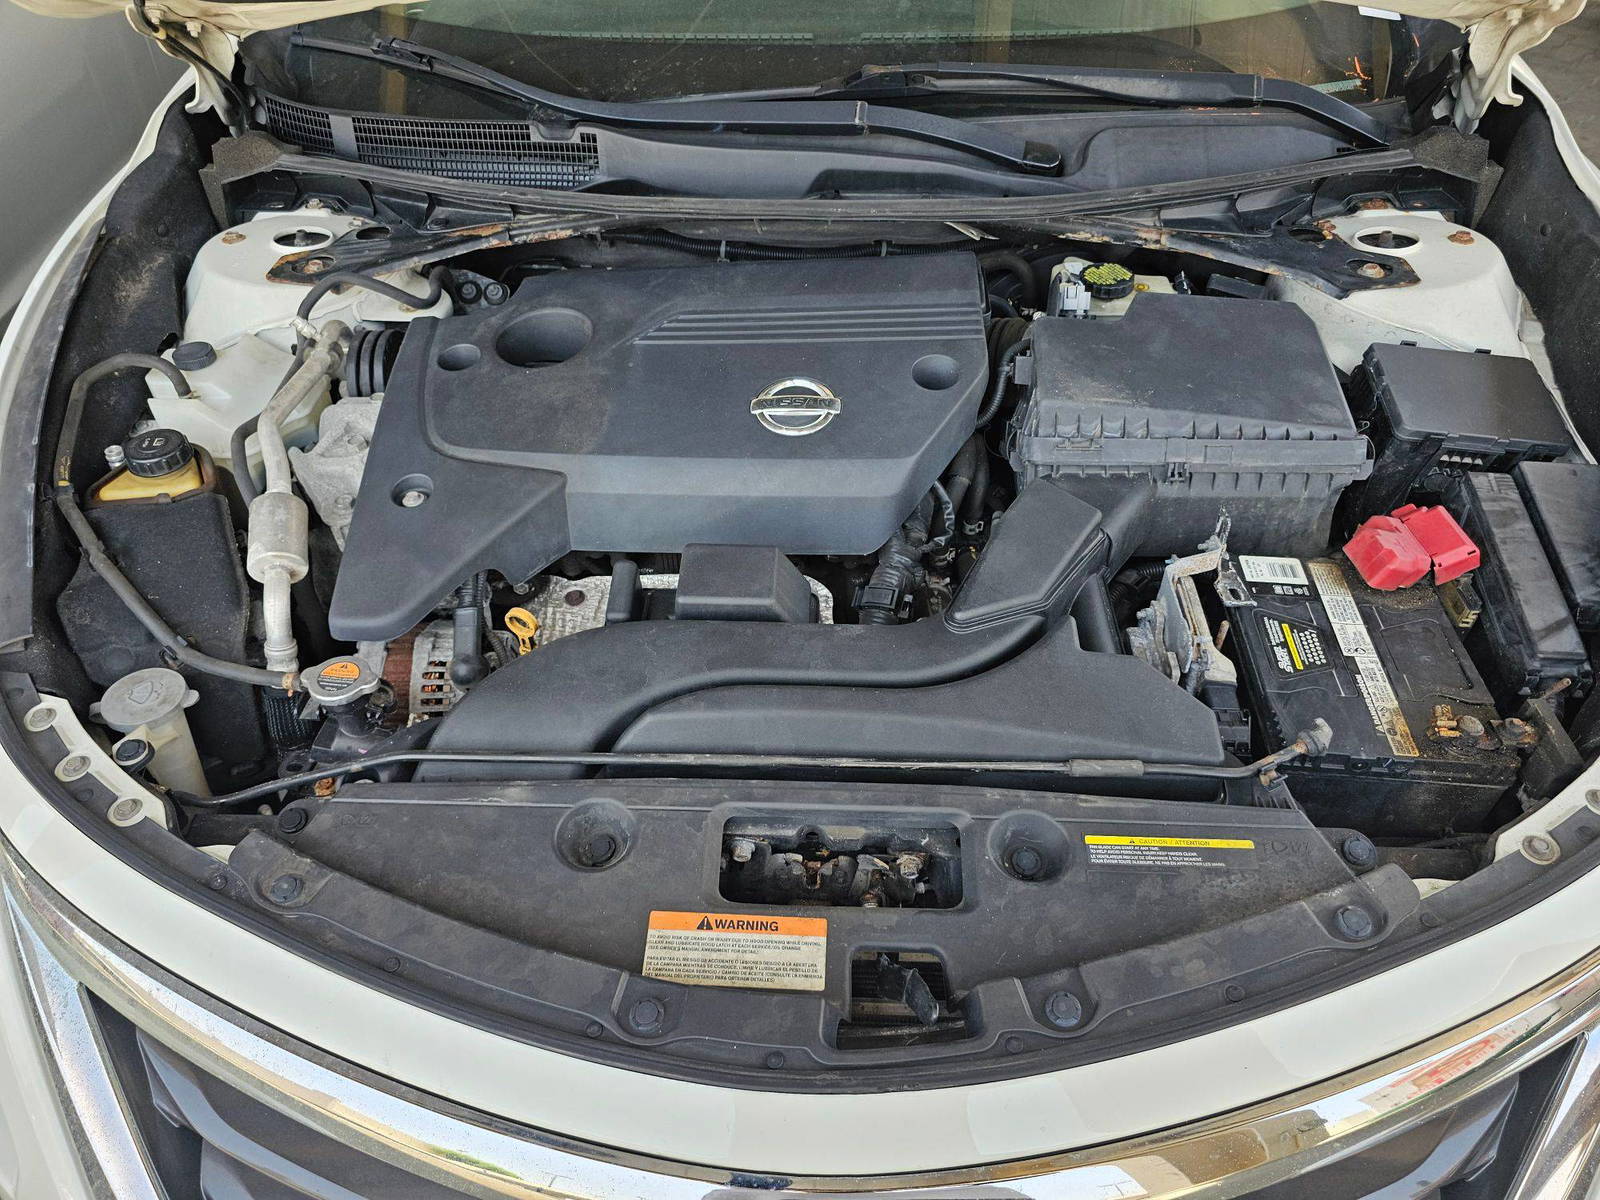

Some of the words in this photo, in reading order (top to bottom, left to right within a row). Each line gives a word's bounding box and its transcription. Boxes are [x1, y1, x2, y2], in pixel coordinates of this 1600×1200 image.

[760, 398, 831, 409] NISSAN
[1280, 647, 1294, 674] START
[714, 919, 779, 932] WARNING
